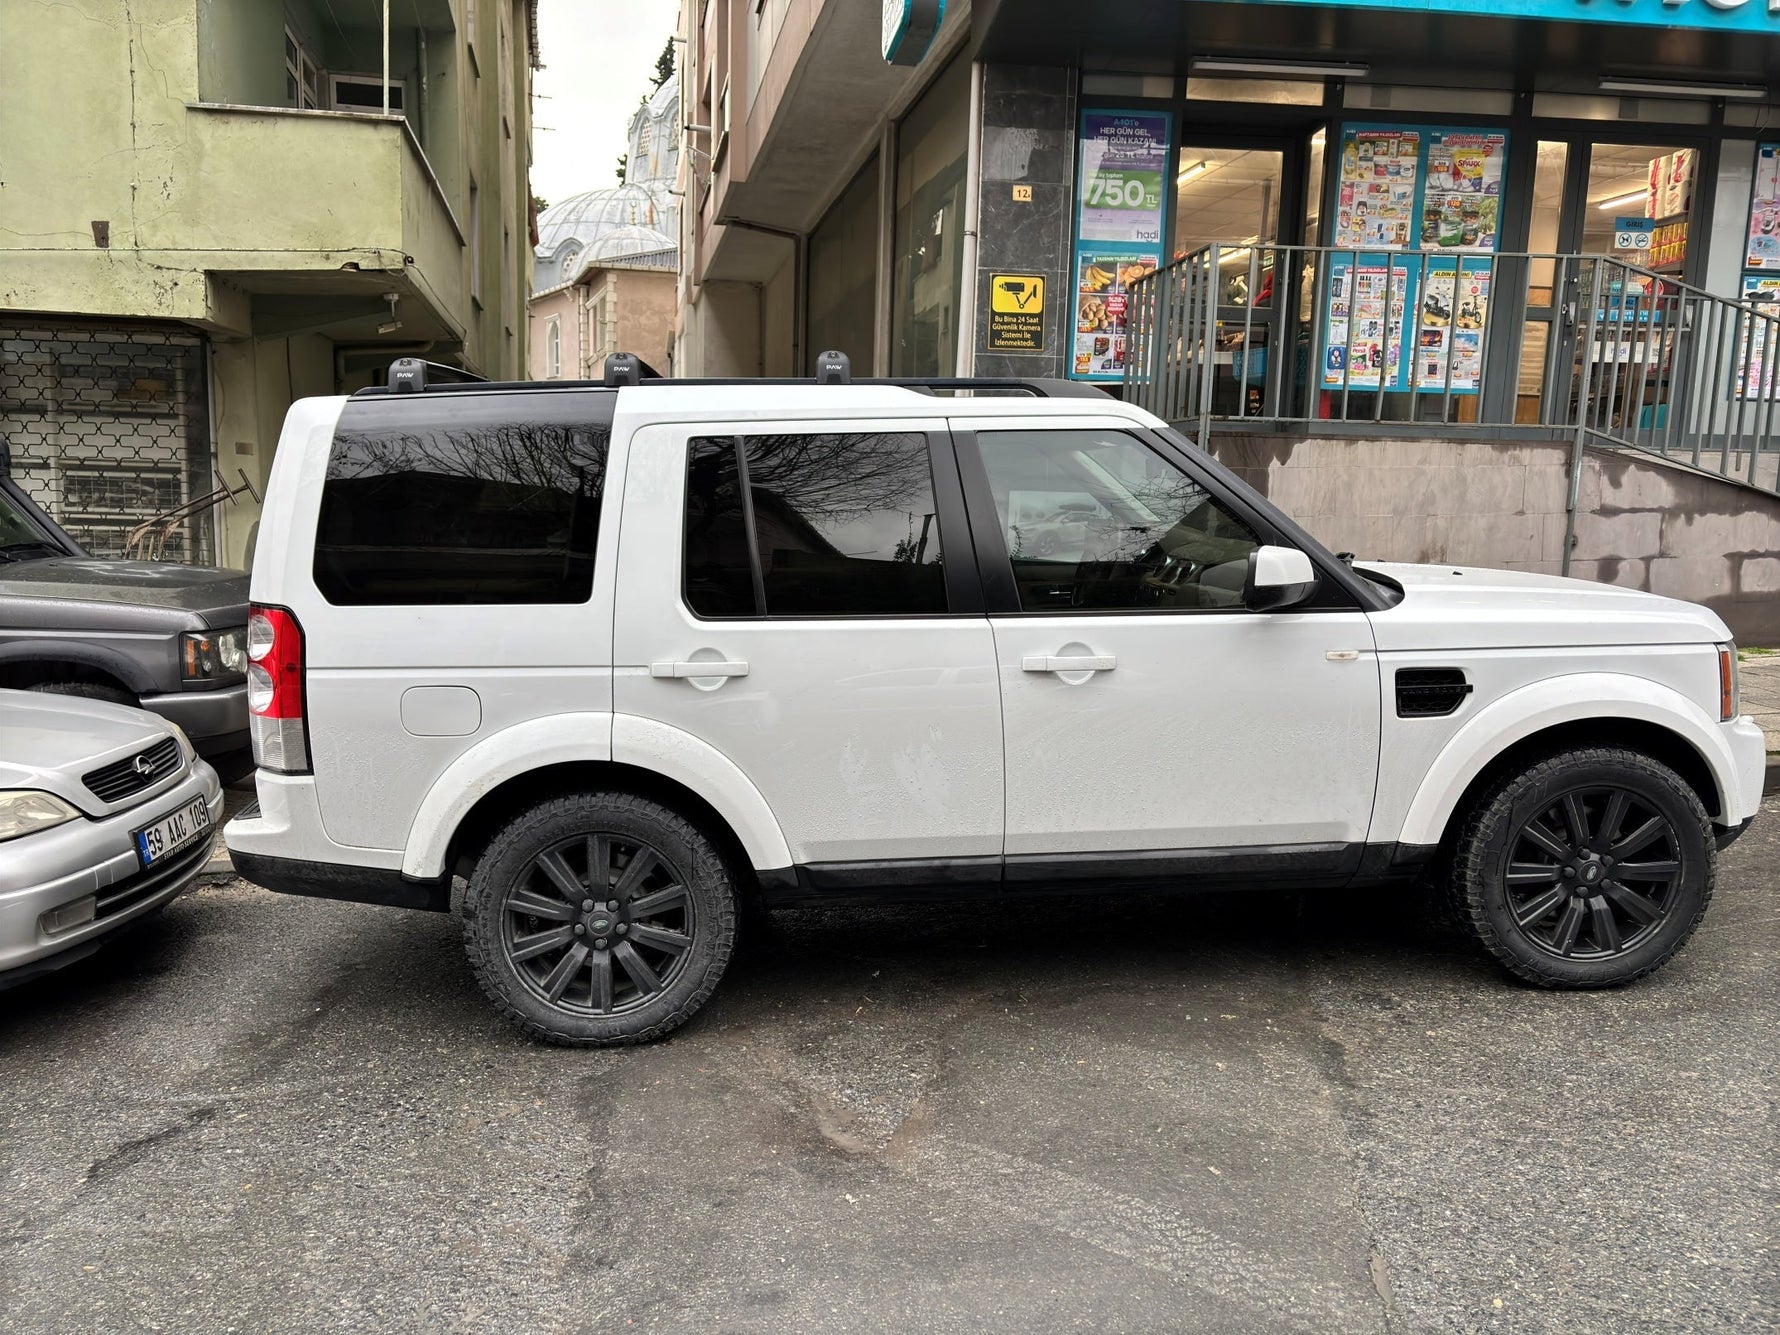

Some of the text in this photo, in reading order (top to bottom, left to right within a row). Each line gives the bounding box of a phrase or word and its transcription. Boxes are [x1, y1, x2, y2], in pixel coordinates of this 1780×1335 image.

[1100, 126, 1151, 137] HER GÜN GEL,
[1110, 135, 1127, 144] GÜN
[1128, 137, 1156, 145] KAZAN!
[1087, 179, 1158, 206] 750 TL
[1136, 230, 1158, 240] hadi
[1004, 315, 1016, 323] Bina
[146, 801, 207, 856] 59 AAC 109
